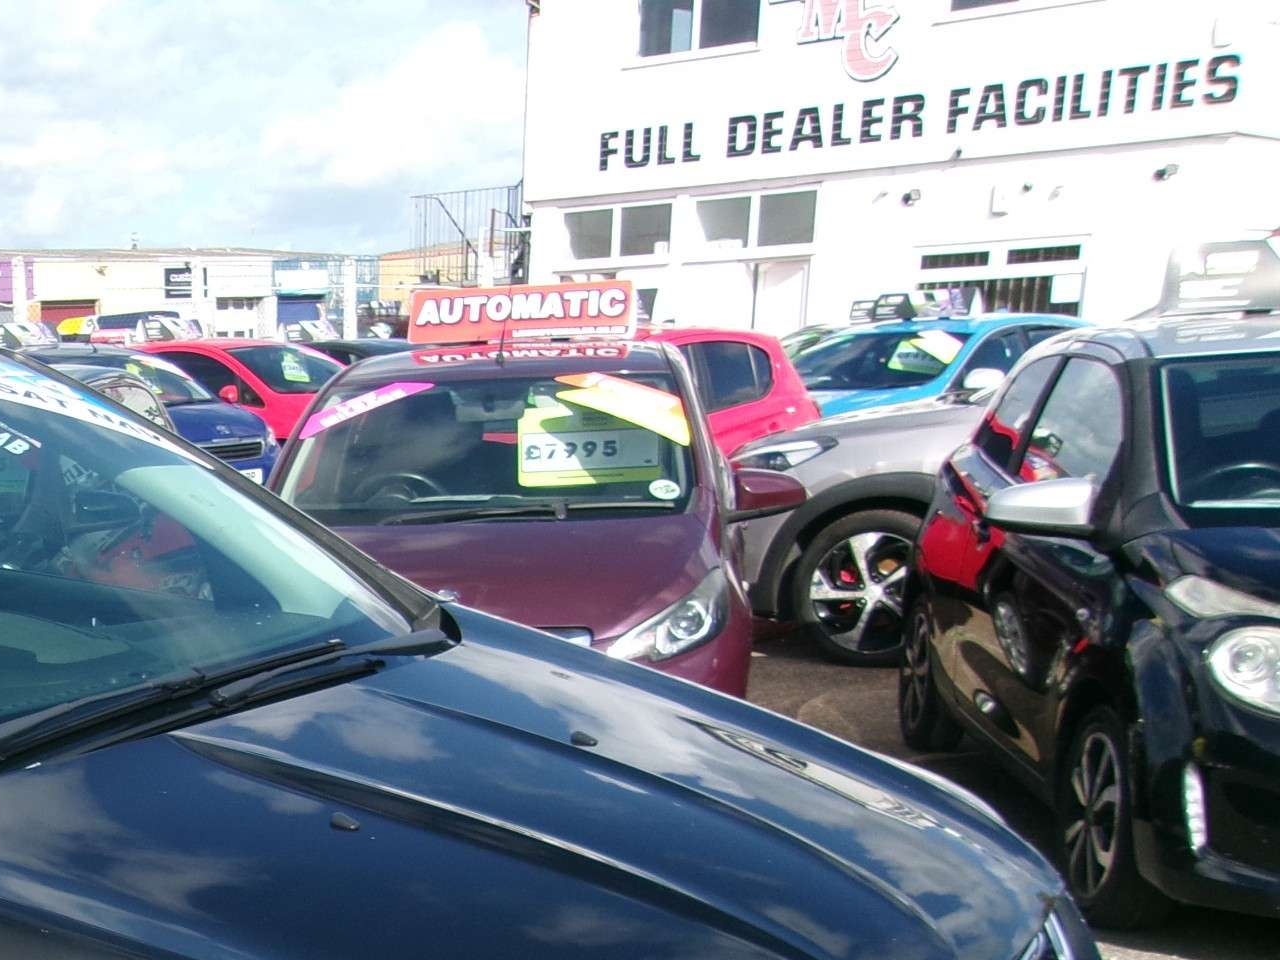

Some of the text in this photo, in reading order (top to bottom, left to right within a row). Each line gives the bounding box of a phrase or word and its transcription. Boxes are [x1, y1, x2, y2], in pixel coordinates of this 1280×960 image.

[599, 53, 1243, 172] FULL DEALER FACILITIES
[415, 288, 627, 326] AUTOMATIC
[525, 440, 618, 461] £7995
